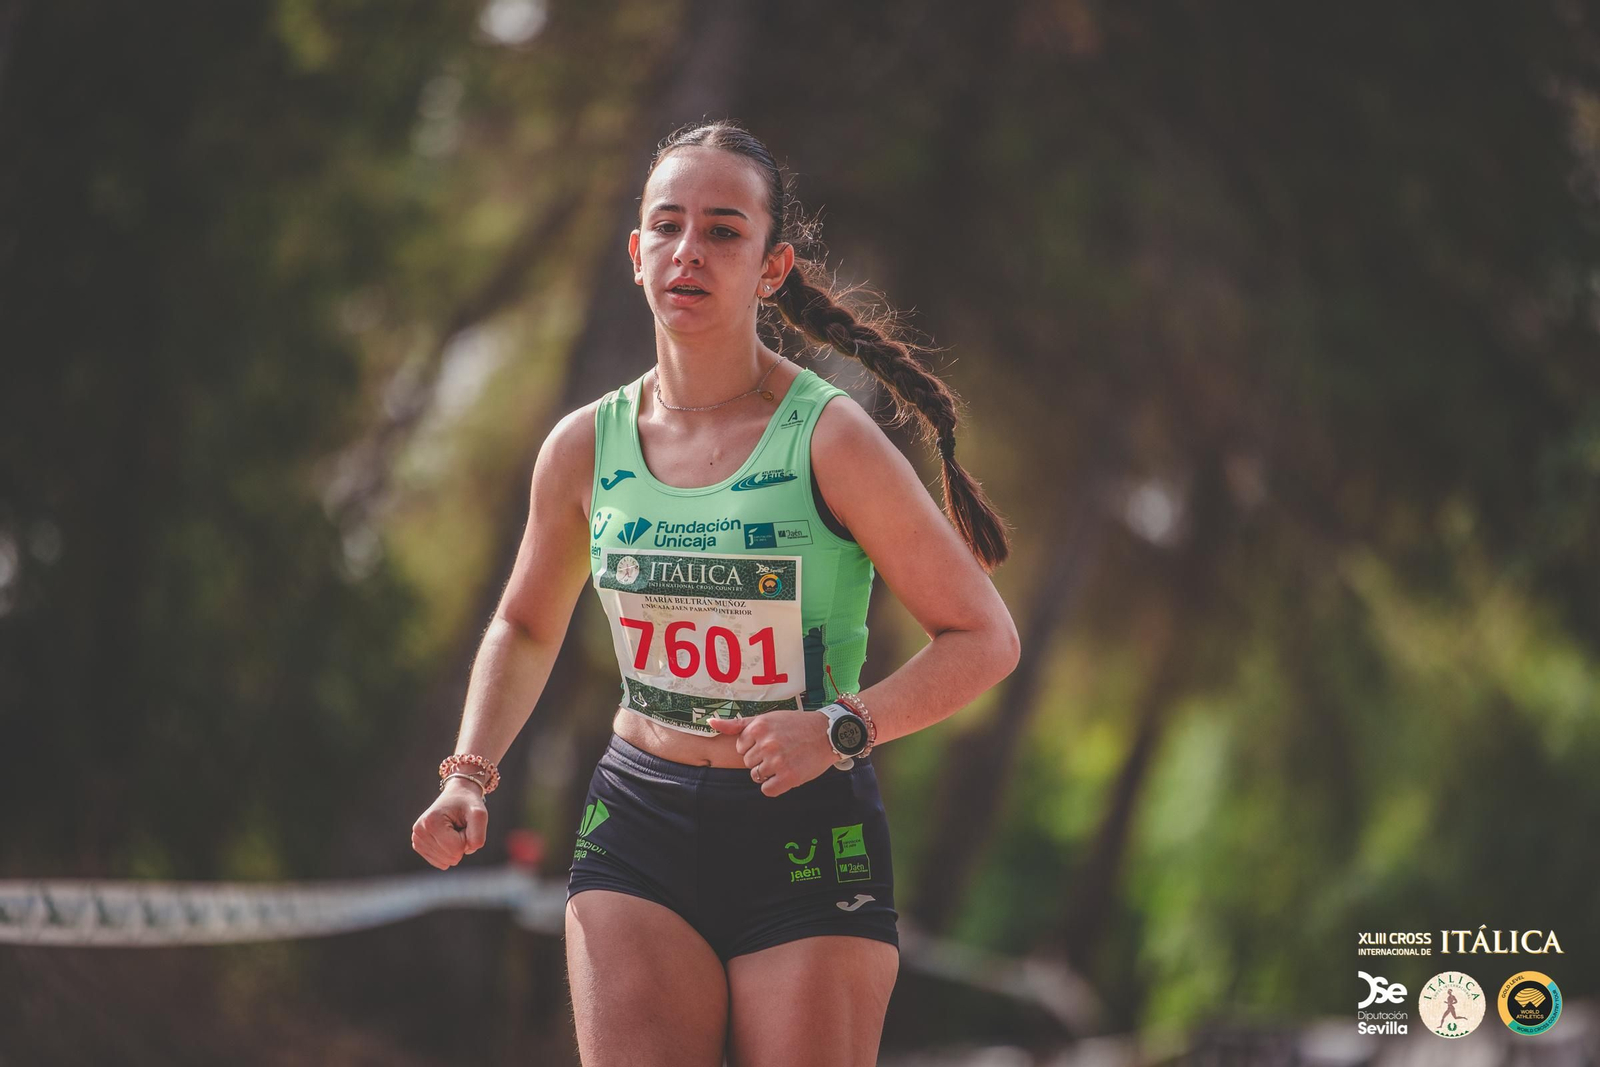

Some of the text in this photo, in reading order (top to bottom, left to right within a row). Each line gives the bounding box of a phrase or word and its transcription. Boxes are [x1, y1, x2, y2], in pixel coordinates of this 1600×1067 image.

[762, 473, 785, 482] ZEUS
[656, 518, 741, 534] Fundación
[654, 534, 716, 550] Unicaja
[648, 558, 743, 586] ITÁLICA
[644, 595, 747, 608] MARÍA BELTRÁN MUÑOZ
[619, 616, 789, 685] 7601
